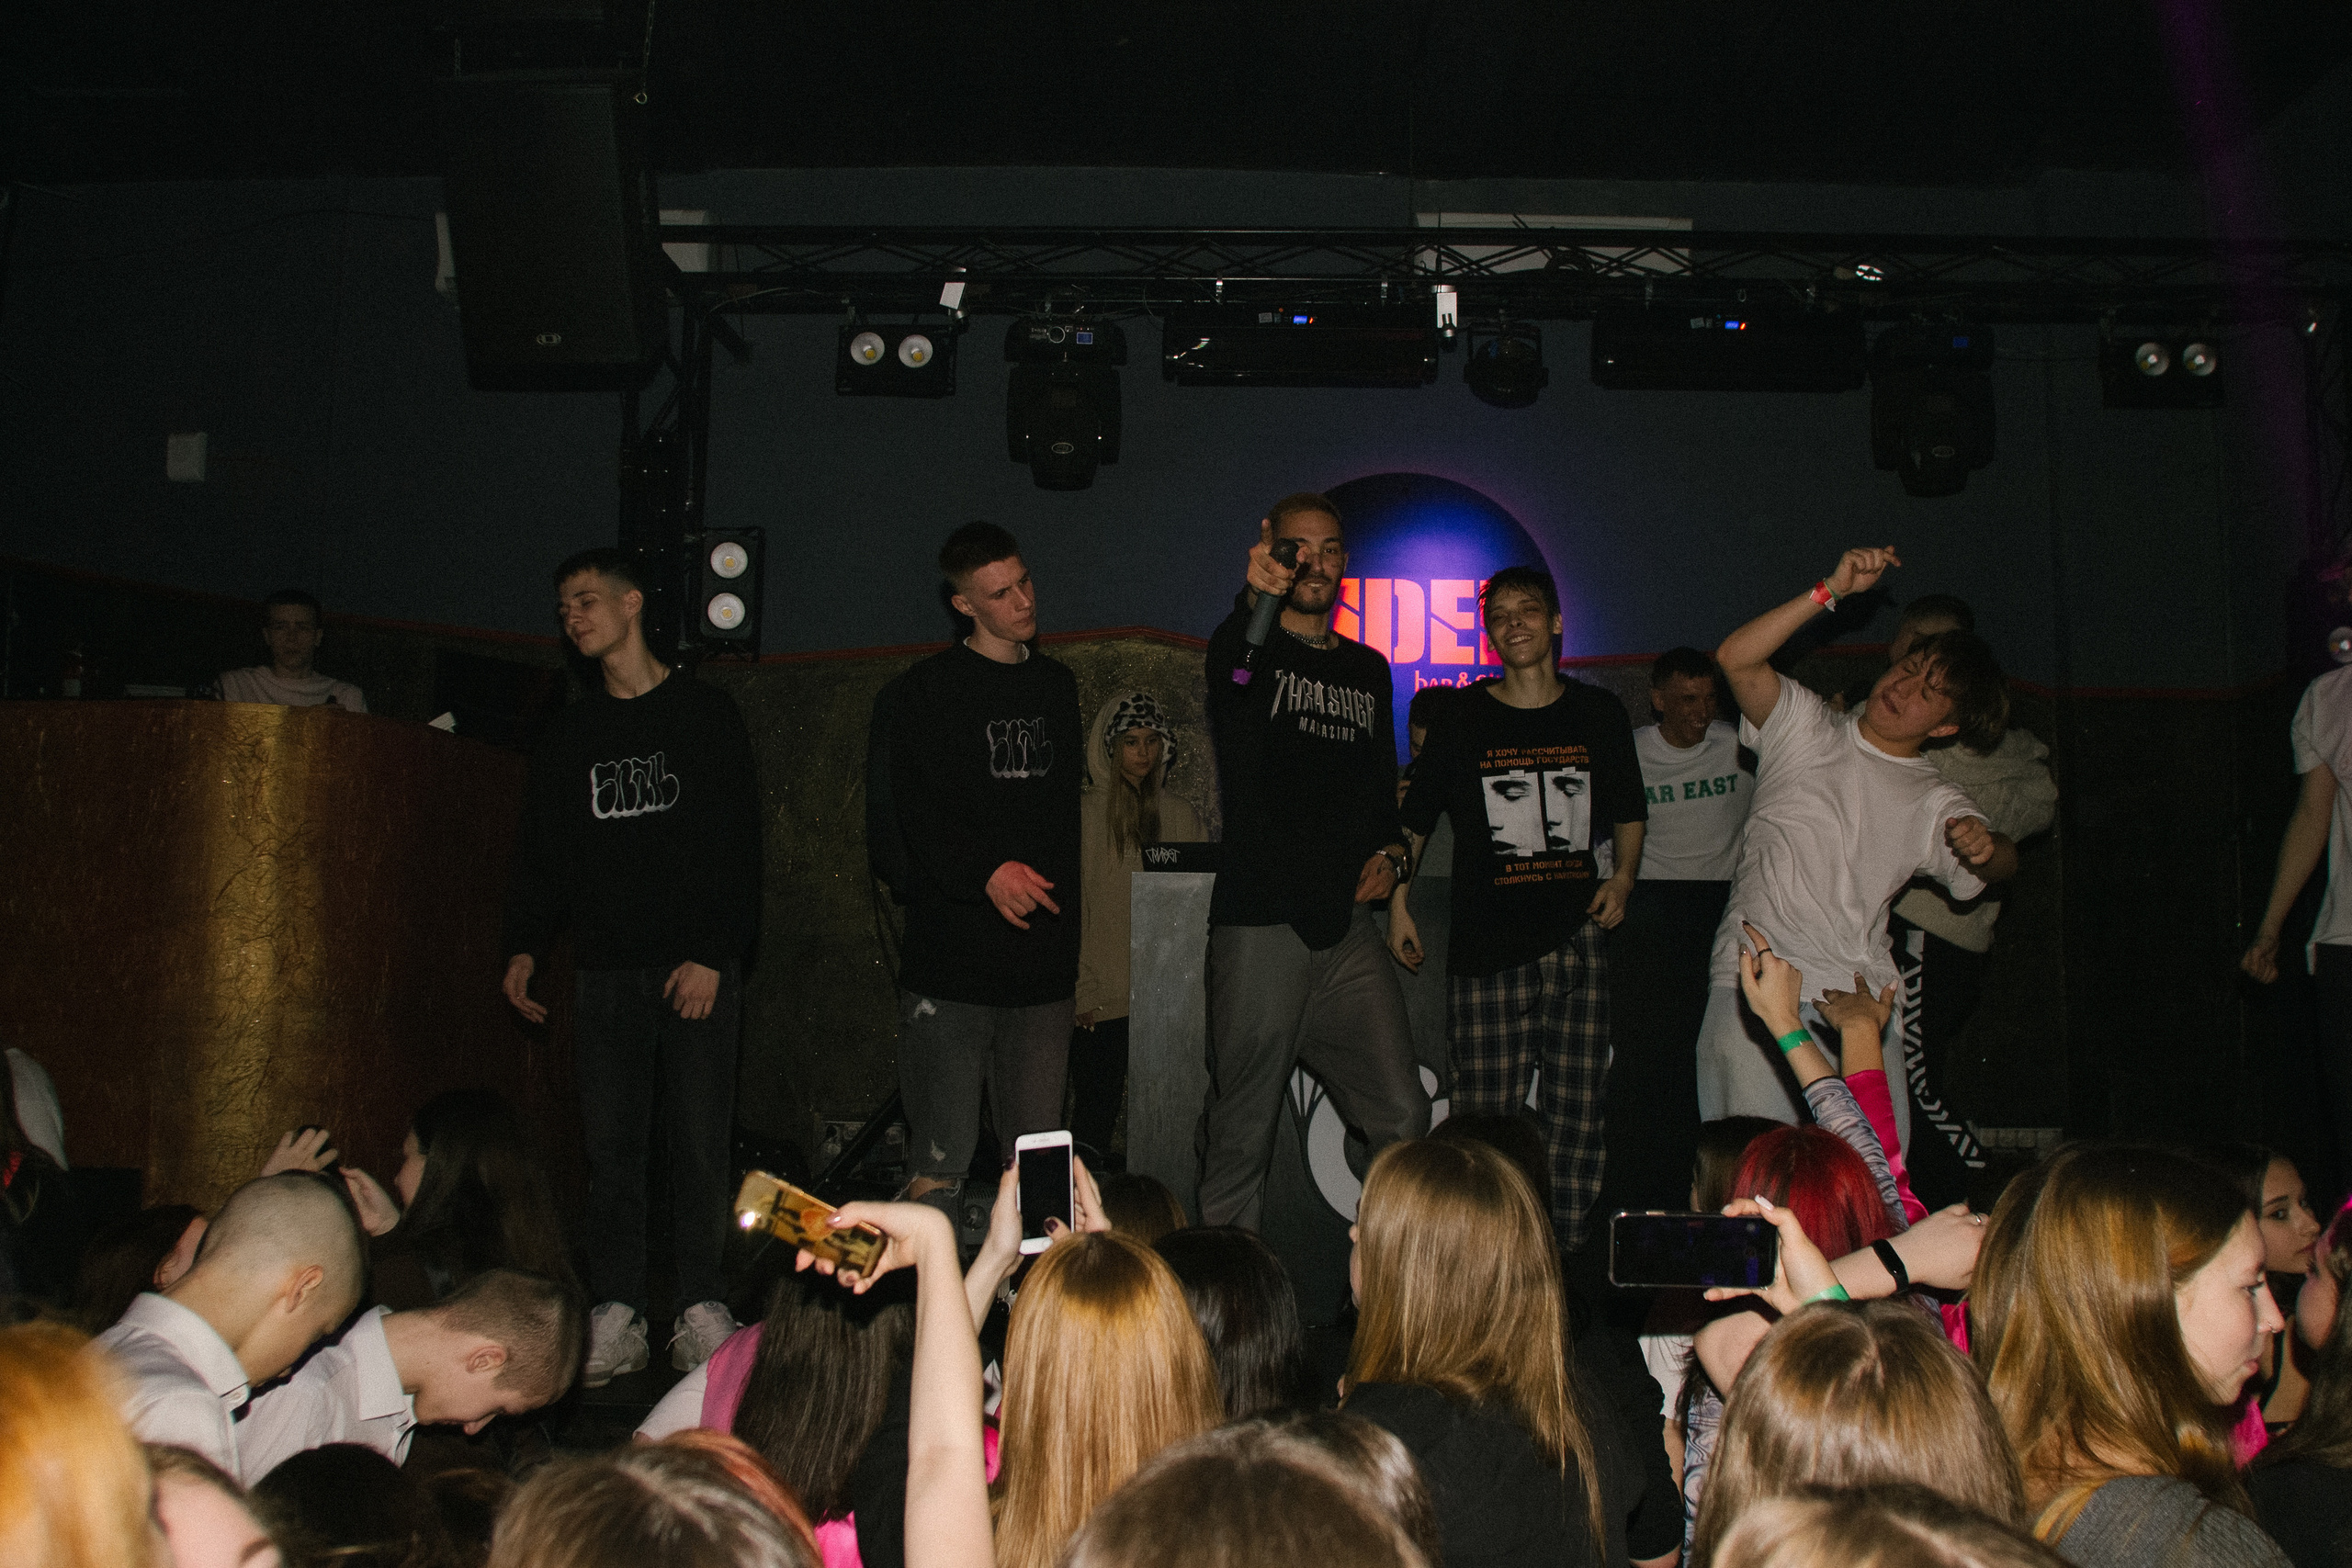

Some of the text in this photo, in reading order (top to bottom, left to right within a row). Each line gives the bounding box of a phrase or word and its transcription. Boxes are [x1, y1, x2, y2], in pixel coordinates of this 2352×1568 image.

[1271, 669, 1375, 740] THRASHER
[1487, 750, 1494, 758] Я
[1496, 748, 1518, 757] ХОЧУ
[1479, 761, 1492, 769] НА
[1495, 757, 1534, 768] ПОМОЩЬ
[1645, 773, 1738, 806] AR EAST
[1505, 864, 1512, 873] В
[1514, 863, 1530, 871] ТОТ
[1494, 874, 1544, 886] СТОЛКНУСЬ
